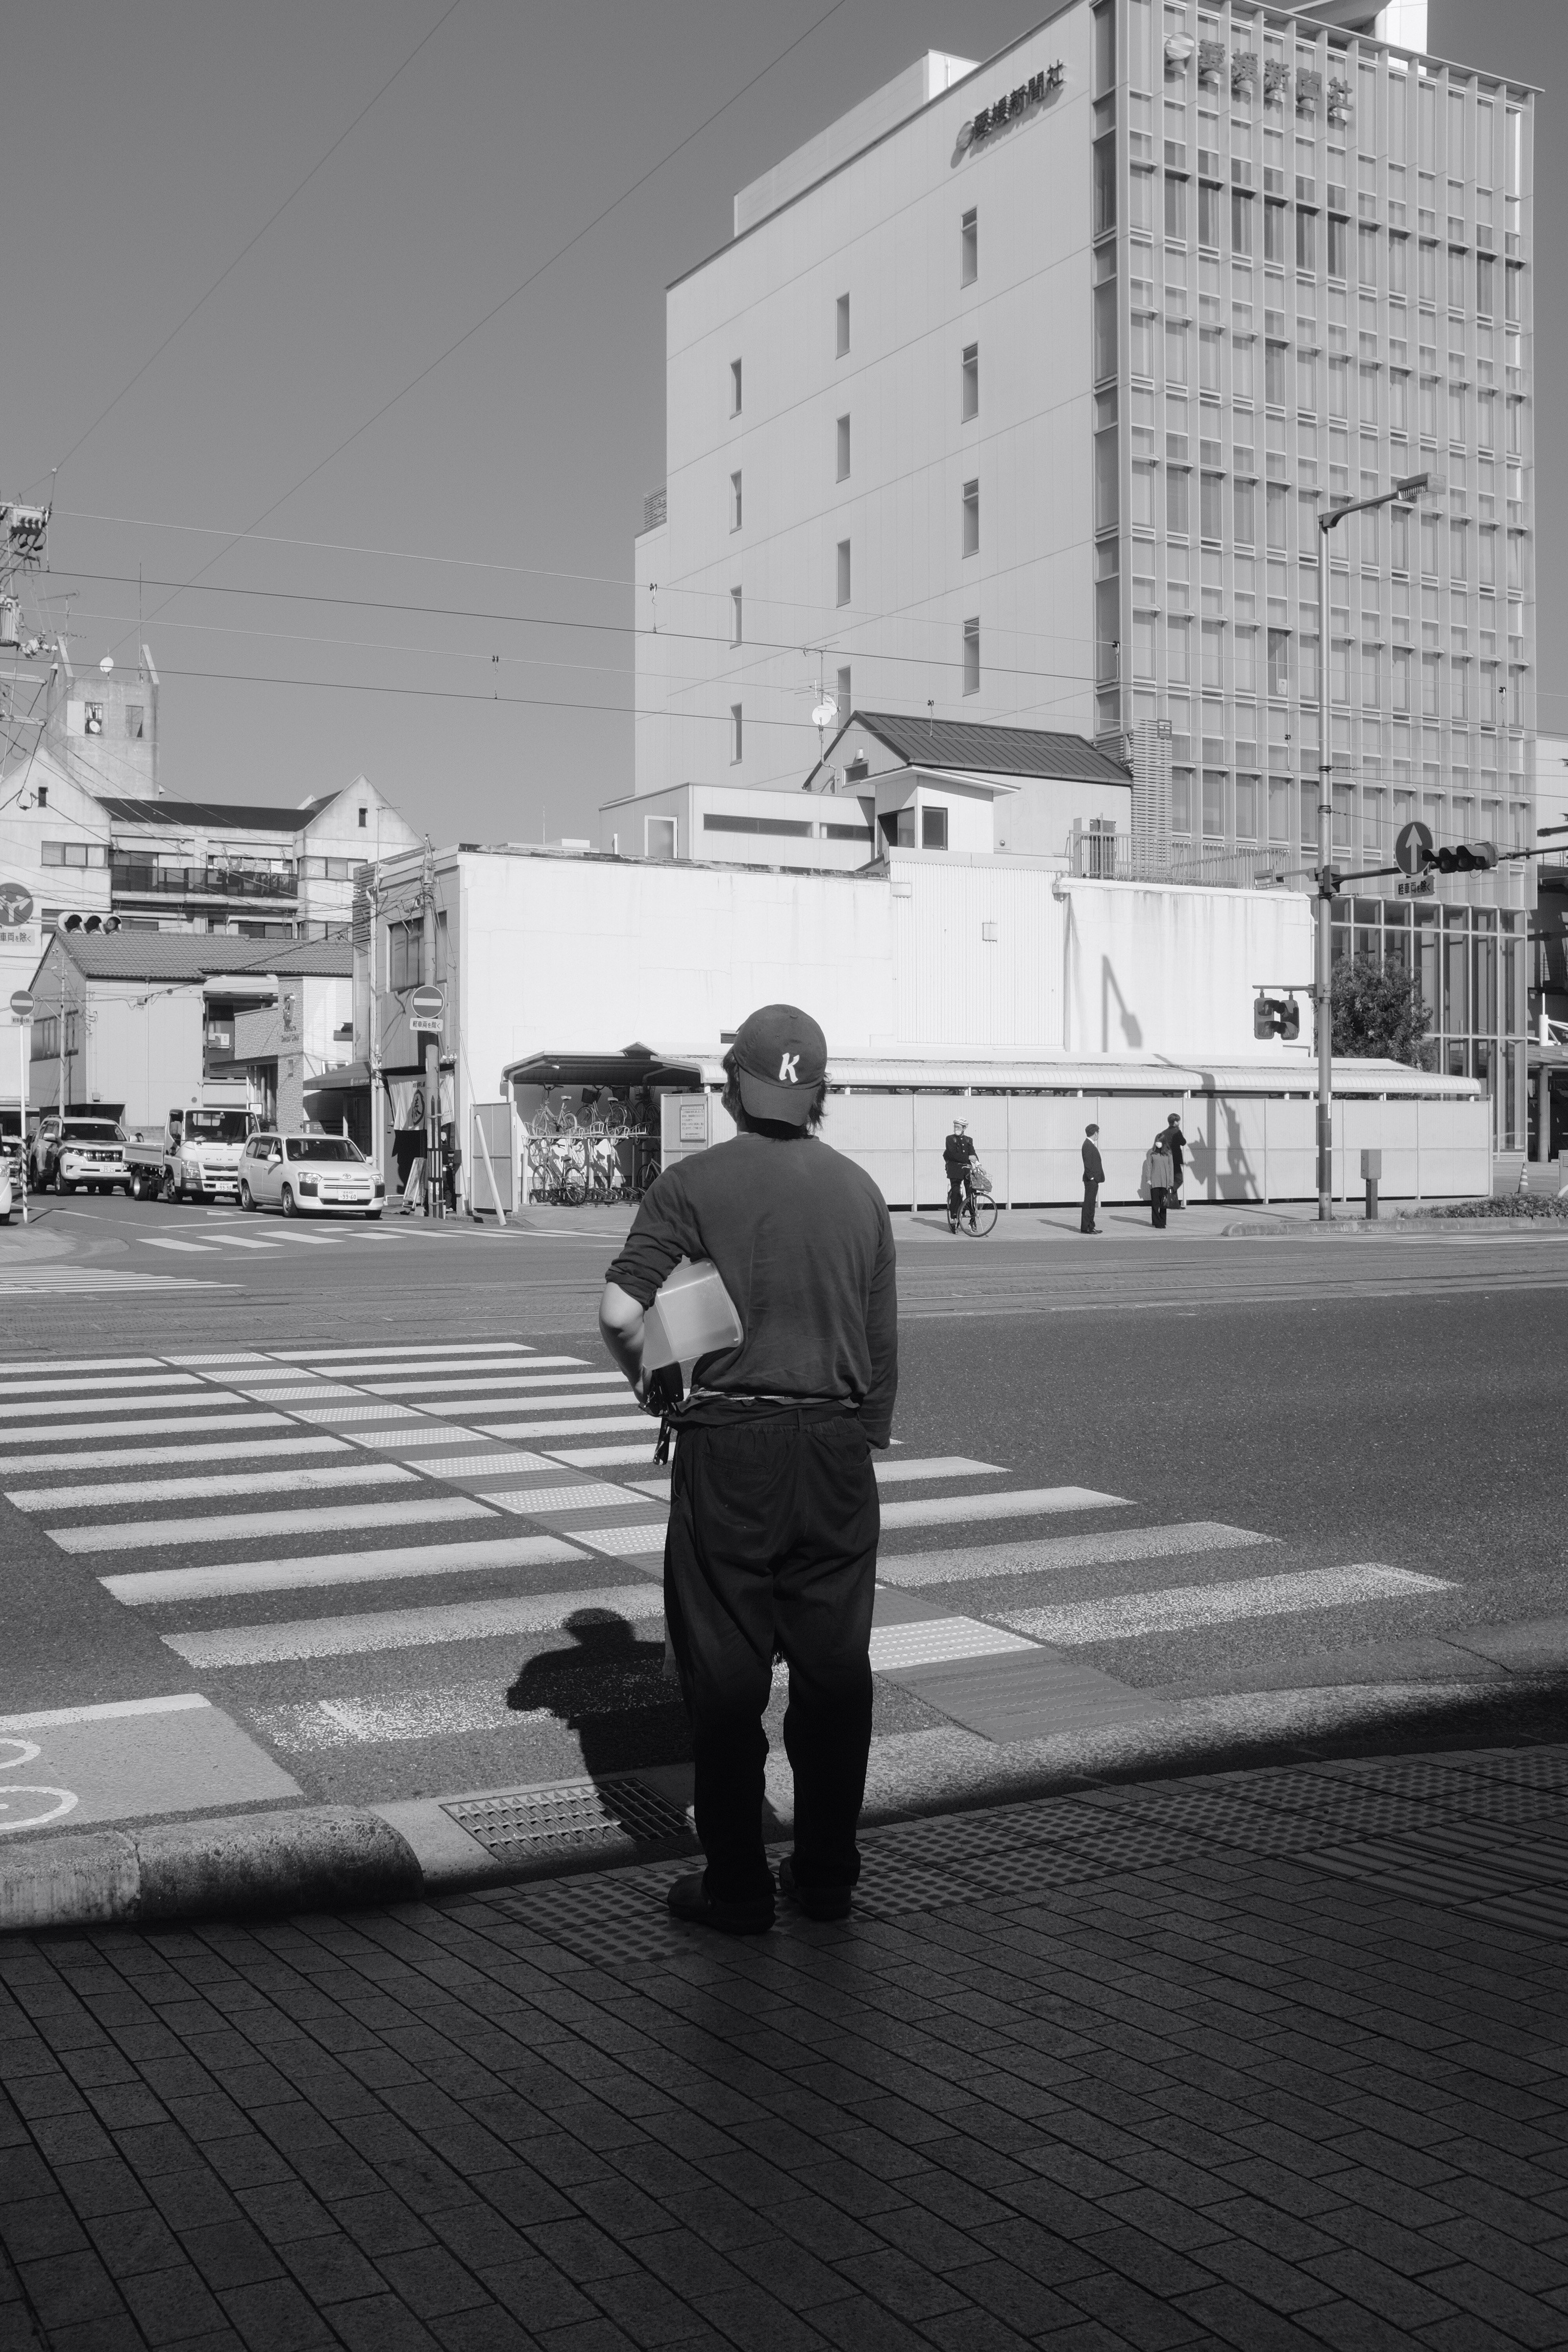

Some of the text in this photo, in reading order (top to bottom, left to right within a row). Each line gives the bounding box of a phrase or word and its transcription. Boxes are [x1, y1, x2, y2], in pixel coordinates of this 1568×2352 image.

[1198, 39, 1354, 111] 愛媛新聞社
[973, 59, 1067, 141] 愛媛新聞社
[1398, 880, 1431, 895] 軽車両を除く
[412, 1020, 441, 1029] 軽車両を除く
[779, 1052, 800, 1083] K
